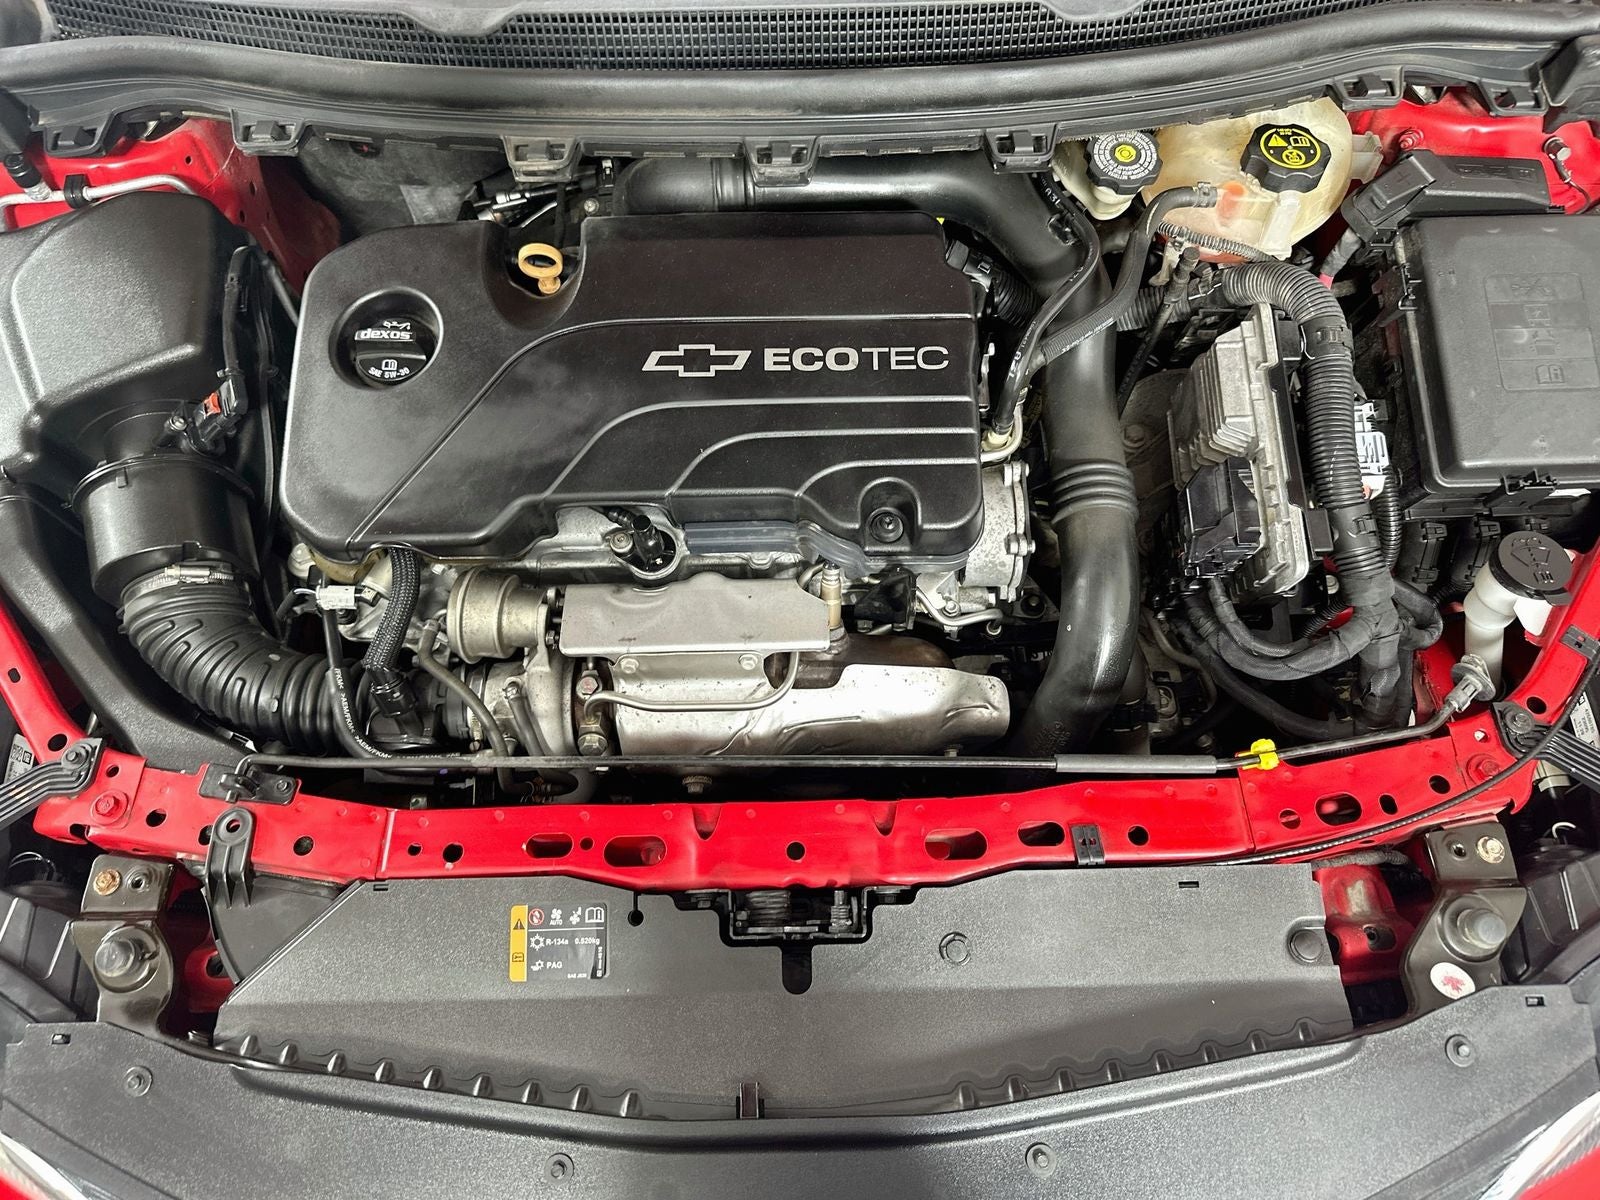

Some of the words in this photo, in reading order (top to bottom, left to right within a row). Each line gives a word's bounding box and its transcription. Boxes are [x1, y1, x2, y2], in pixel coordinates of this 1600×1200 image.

[360, 328, 412, 340] dexos
[764, 346, 949, 371] ECOTEC
[368, 367, 383, 378] SAE
[384, 367, 410, 379] 5W-30
[545, 938, 569, 946] R-134a
